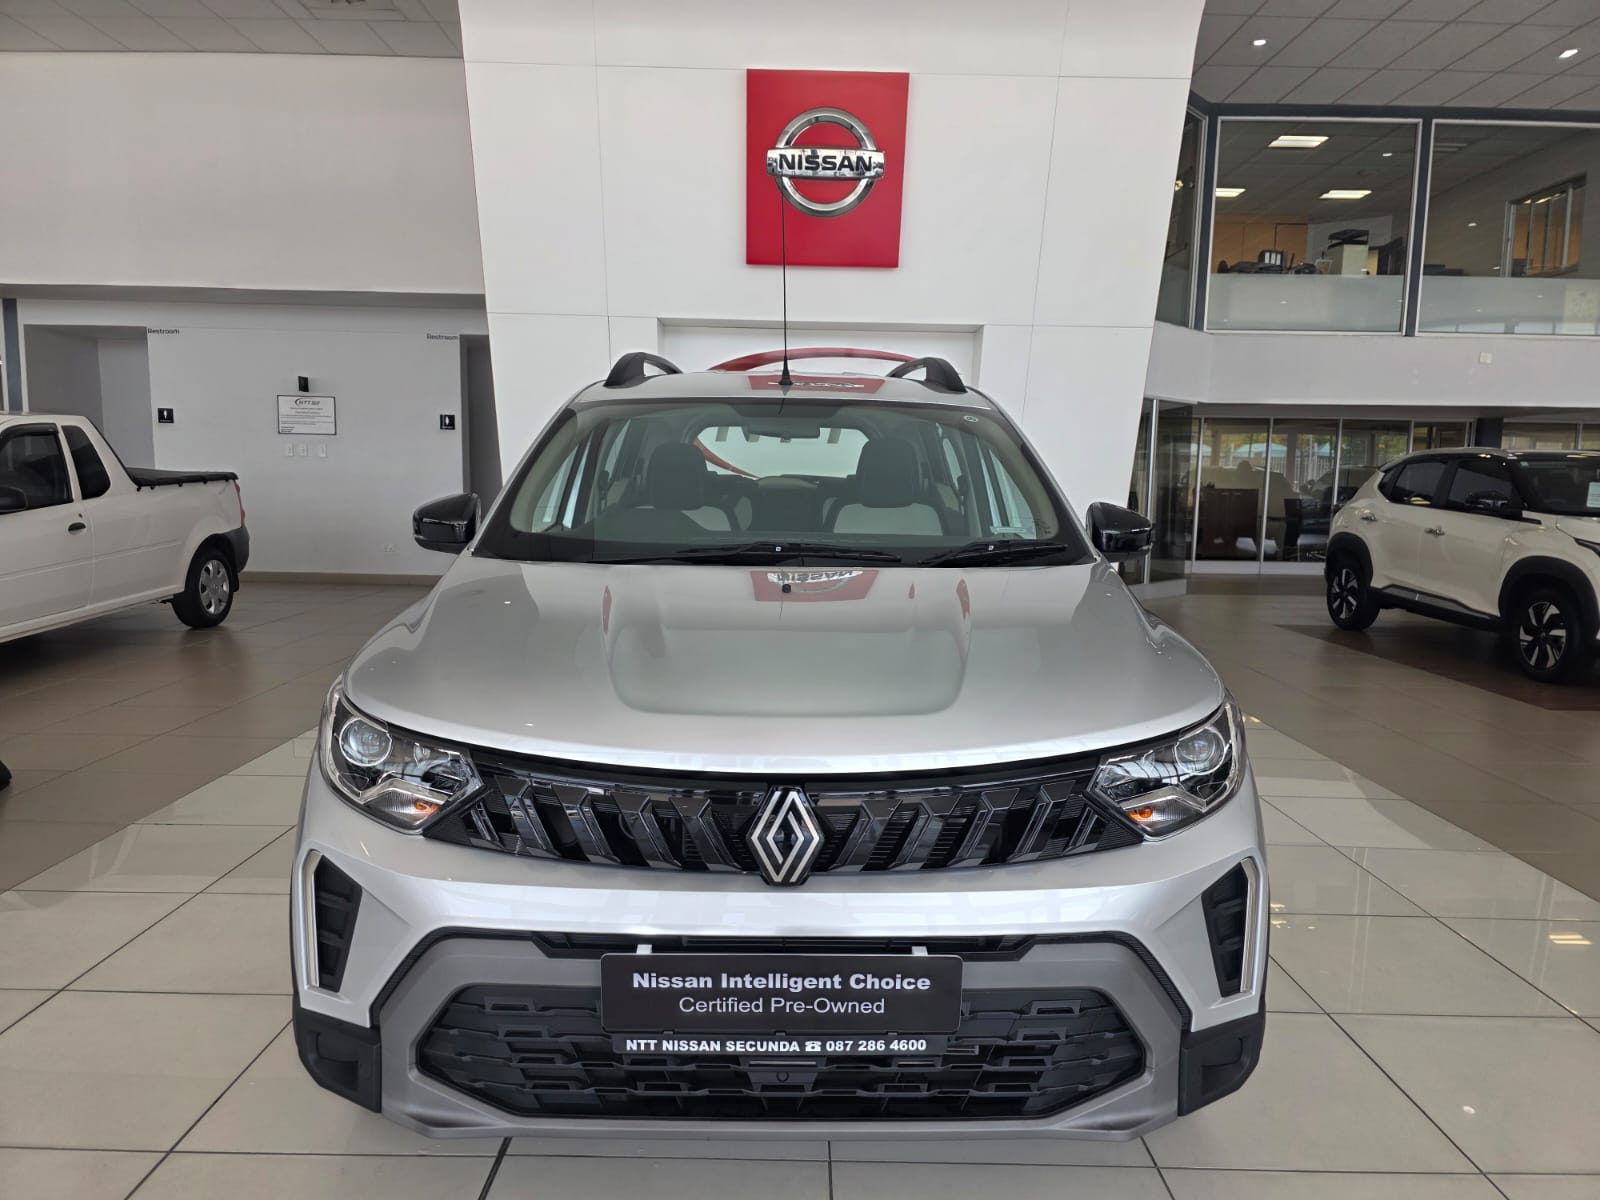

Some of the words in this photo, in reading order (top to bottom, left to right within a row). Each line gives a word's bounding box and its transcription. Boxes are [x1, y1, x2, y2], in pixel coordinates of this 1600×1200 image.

[778, 153, 872, 171] NISSAN
[147, 327, 180, 335] Restroom
[426, 333, 459, 341] Restroom
[632, 972, 713, 989] Nissan
[721, 973, 842, 993] Intelligent
[849, 973, 931, 990] Choice
[679, 996, 763, 1013] Certified
[771, 997, 885, 1014] Pre-Owned
[626, 1039, 658, 1051] NTT
[662, 1039, 721, 1051] NISSAN
[725, 1040, 800, 1052] SECUNDA
[826, 1040, 854, 1051] 087
[858, 1040, 885, 1051] 286
[889, 1039, 927, 1051] 4600
